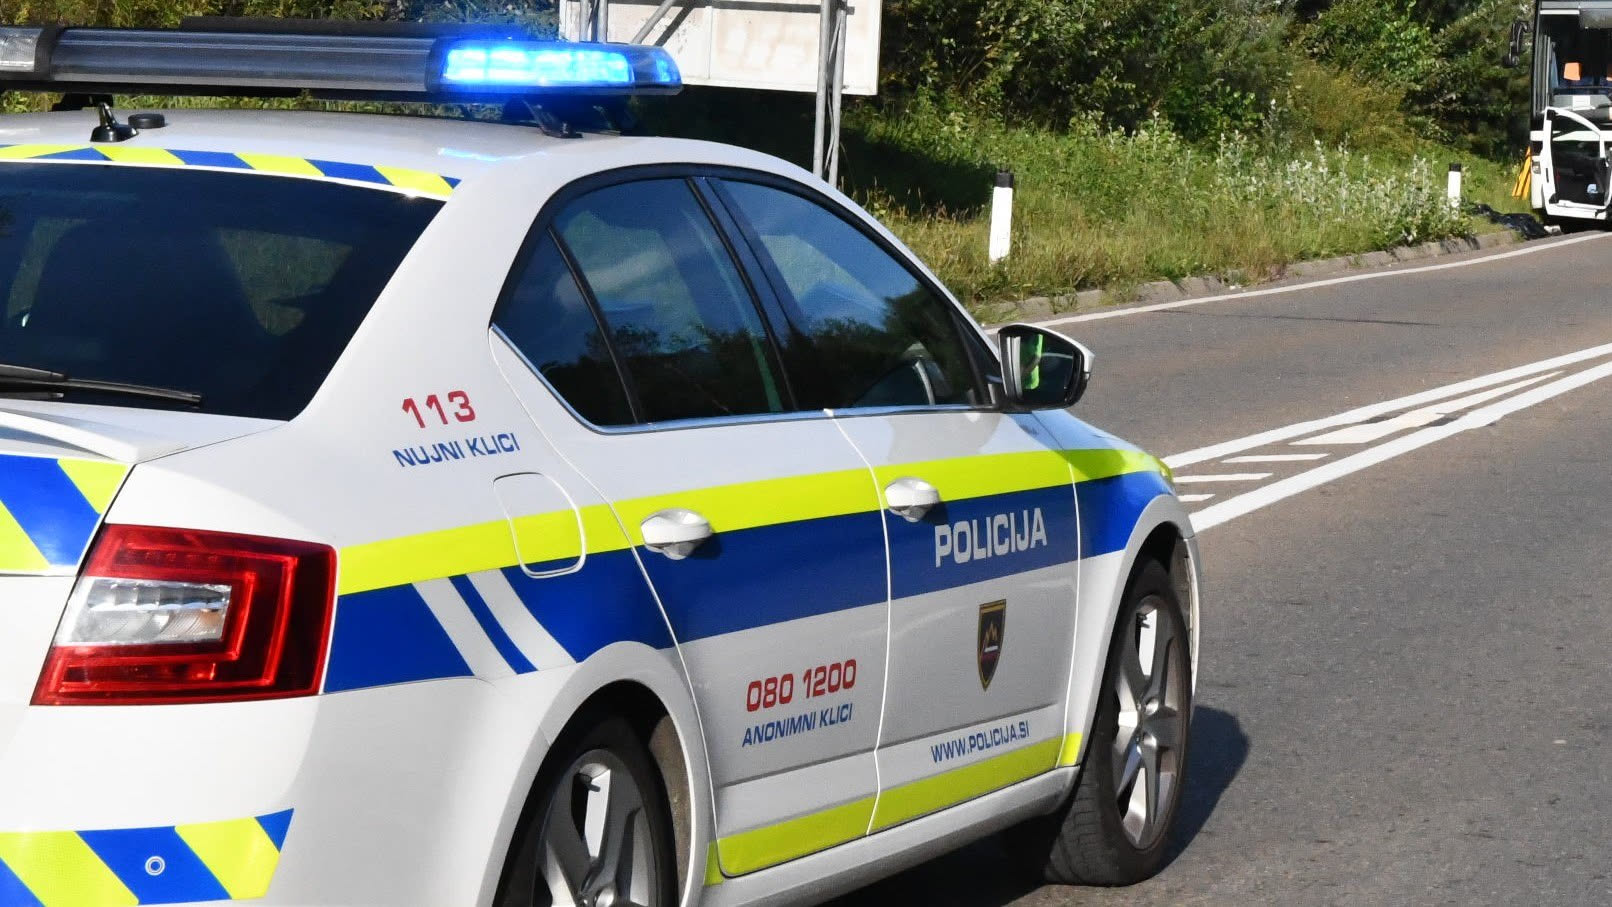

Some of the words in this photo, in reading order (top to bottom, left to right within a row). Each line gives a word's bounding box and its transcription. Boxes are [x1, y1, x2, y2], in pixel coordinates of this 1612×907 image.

[402, 390, 476, 428] 113
[392, 441, 465, 467] NUJNI
[466, 433, 520, 457] KLICI
[934, 507, 1048, 568] POLICIJA
[746, 673, 794, 712] 080
[803, 659, 856, 699] 1200
[742, 712, 816, 747] ANONIMNI
[820, 703, 853, 728] KLICI
[930, 720, 1030, 763] WWW.POLICIJA.SI
